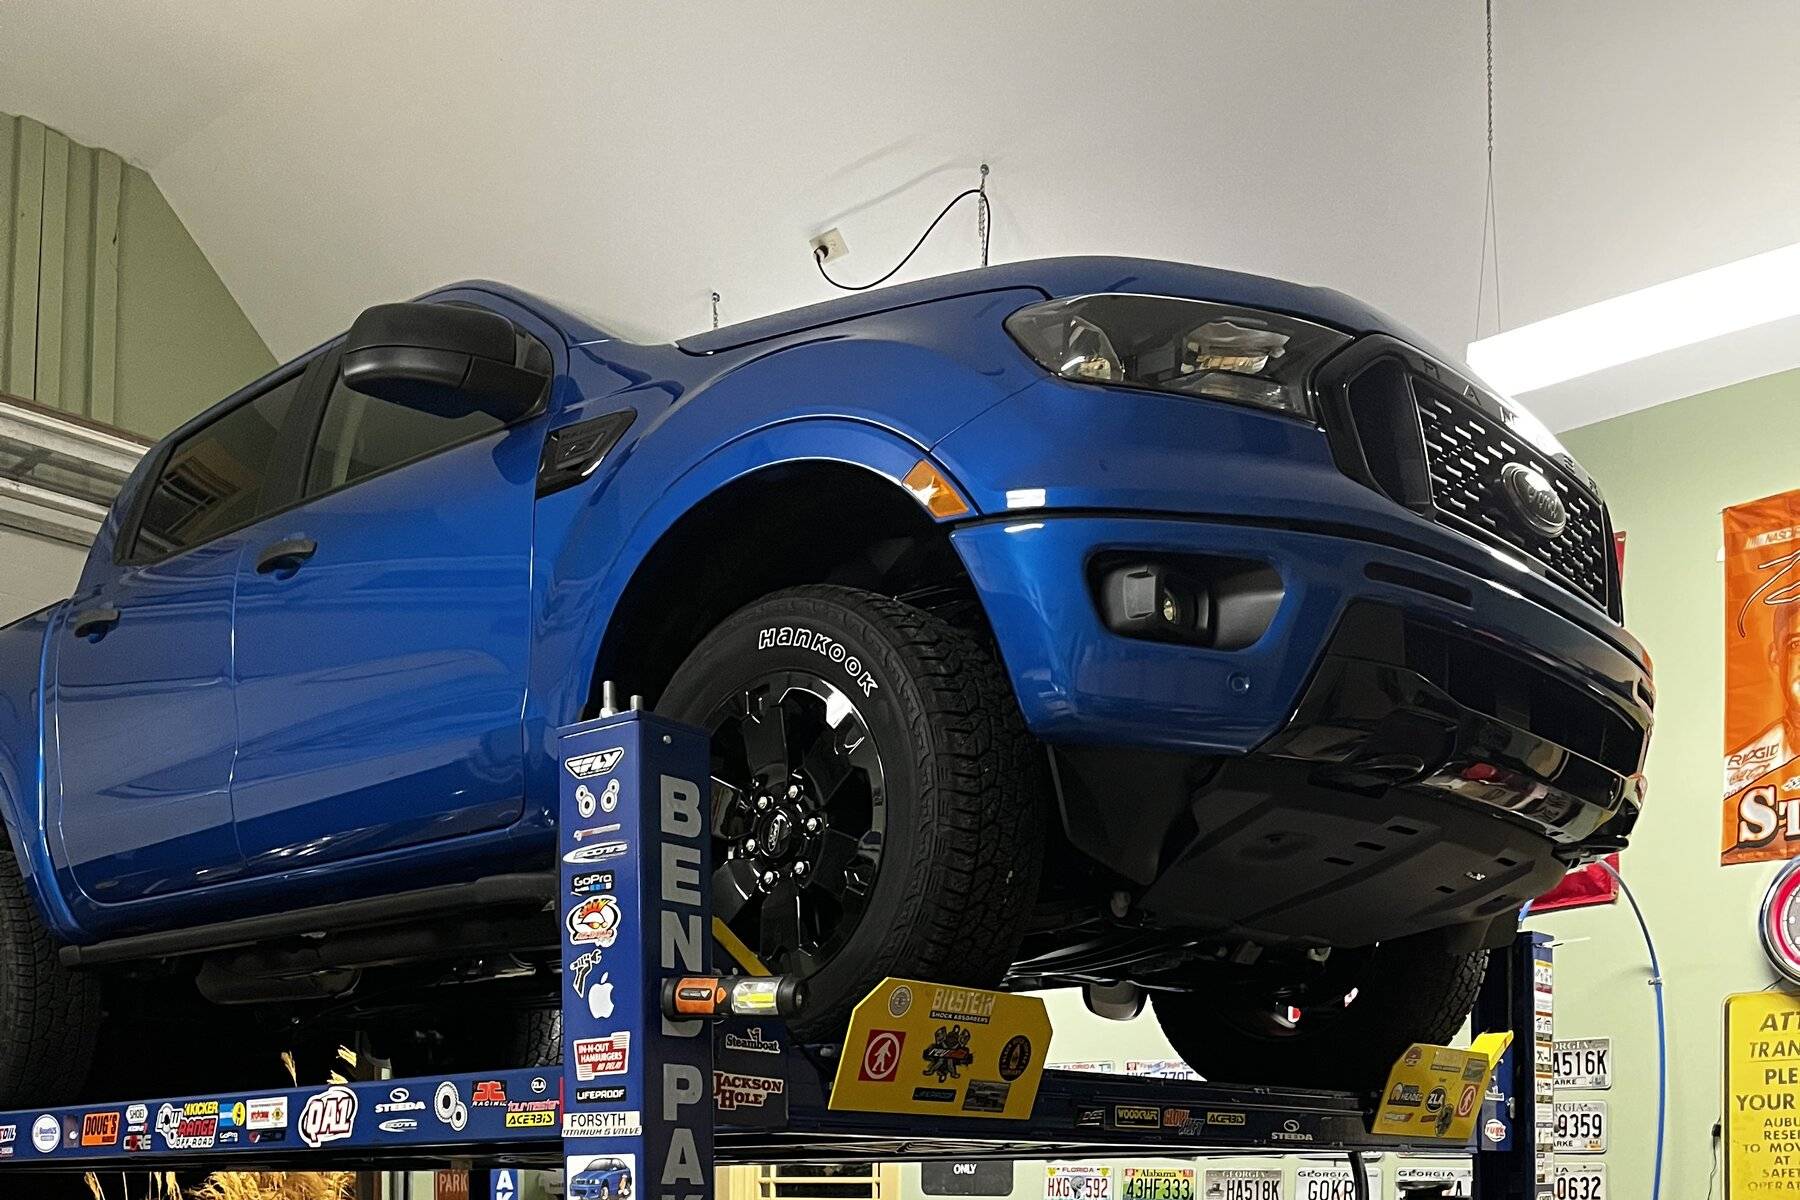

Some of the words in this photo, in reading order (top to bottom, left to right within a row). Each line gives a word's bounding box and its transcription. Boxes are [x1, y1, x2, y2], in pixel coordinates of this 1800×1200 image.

[573, 873, 612, 887] GoPro
[931, 987, 997, 1016] BILSTEIN
[578, 1042, 610, 1054] IN-N-OUT
[726, 1034, 779, 1052] Steamboat
[580, 1051, 623, 1063] HAMBURGERS
[714, 1071, 783, 1094] JACKSON
[1764, 1067, 1799, 1085] PLE
[576, 1089, 625, 1100] LIFEPROOF
[720, 1087, 763, 1110] HOLE
[375, 1101, 426, 1114] STEEDA
[1736, 1093, 1795, 1112] YOUR
[84, 1113, 118, 1136] DOUG'S
[305, 1096, 352, 1143] QA1
[508, 1113, 553, 1125] ACERBIS
[570, 1113, 626, 1127] FORSYTH
[613, 1127, 640, 1135] VALVE
[1271, 1131, 1314, 1142] STEEDA
[1742, 1143, 1761, 1154] TO
[1773, 1155, 1791, 1166] AT
[953, 1162, 978, 1175] ONLY
[1140, 1168, 1177, 1178] Alabama
[1297, 1170, 1350, 1178] GEORGIA
[1397, 1169, 1455, 1178] GEORGIA
[1047, 1177, 1070, 1197] HXG
[1085, 1178, 1108, 1199] 592
[1126, 1178, 1191, 1200] 43HF333
[1557, 1175, 1601, 1200] 0632
